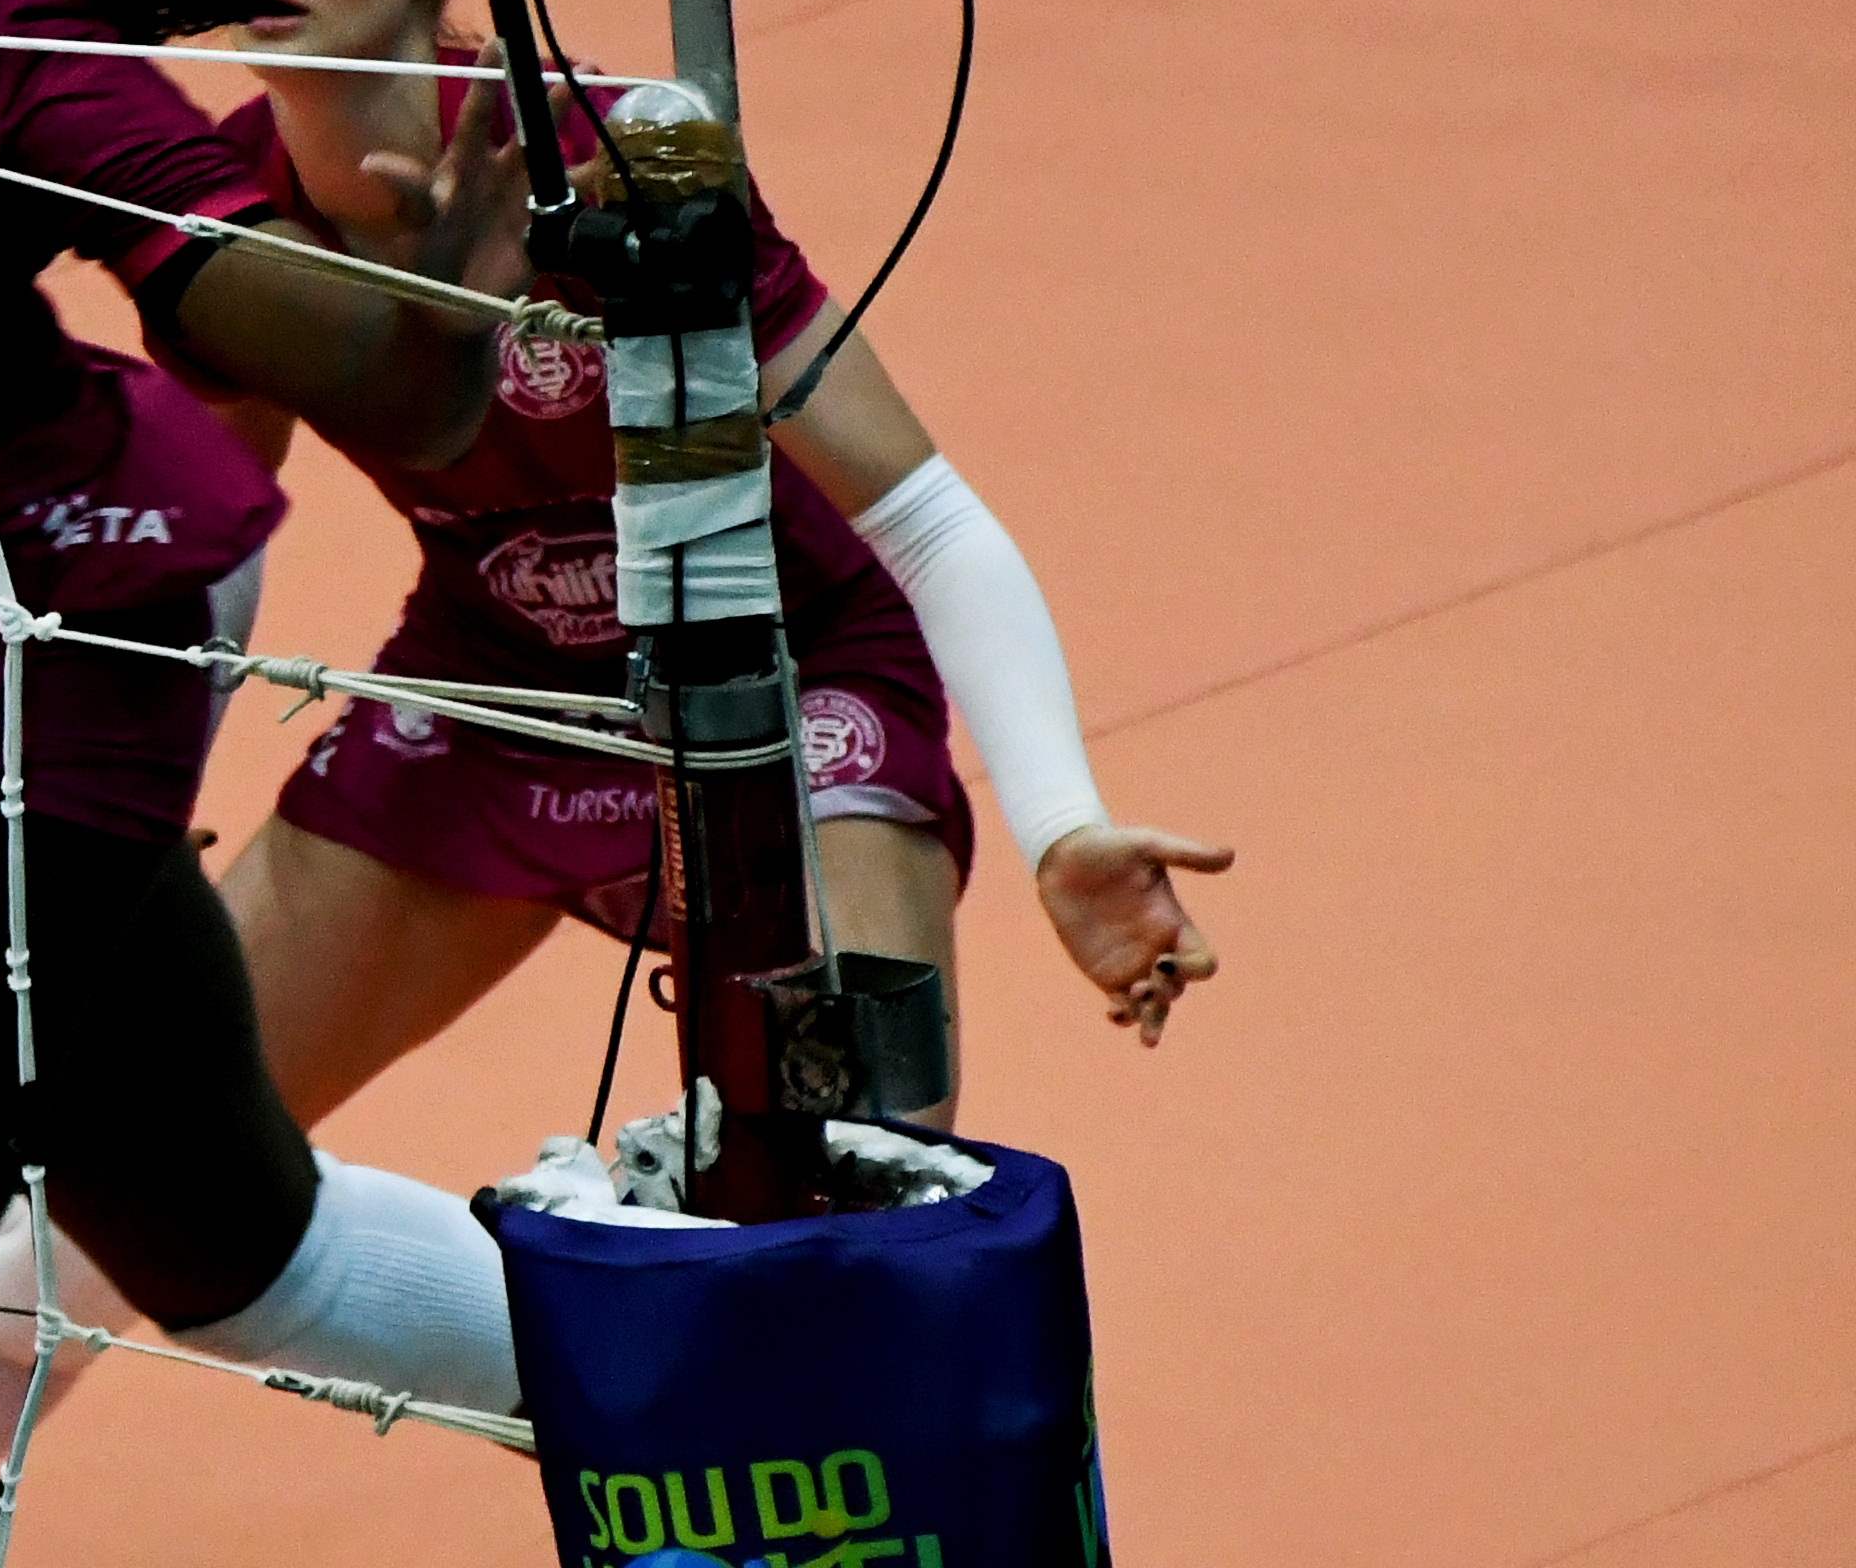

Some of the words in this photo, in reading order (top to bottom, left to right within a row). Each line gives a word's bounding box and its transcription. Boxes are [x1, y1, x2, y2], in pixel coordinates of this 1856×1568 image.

[529, 784, 658, 824] TURISM
[579, 1466, 735, 1554] SOU
[748, 1448, 891, 1538] DO
